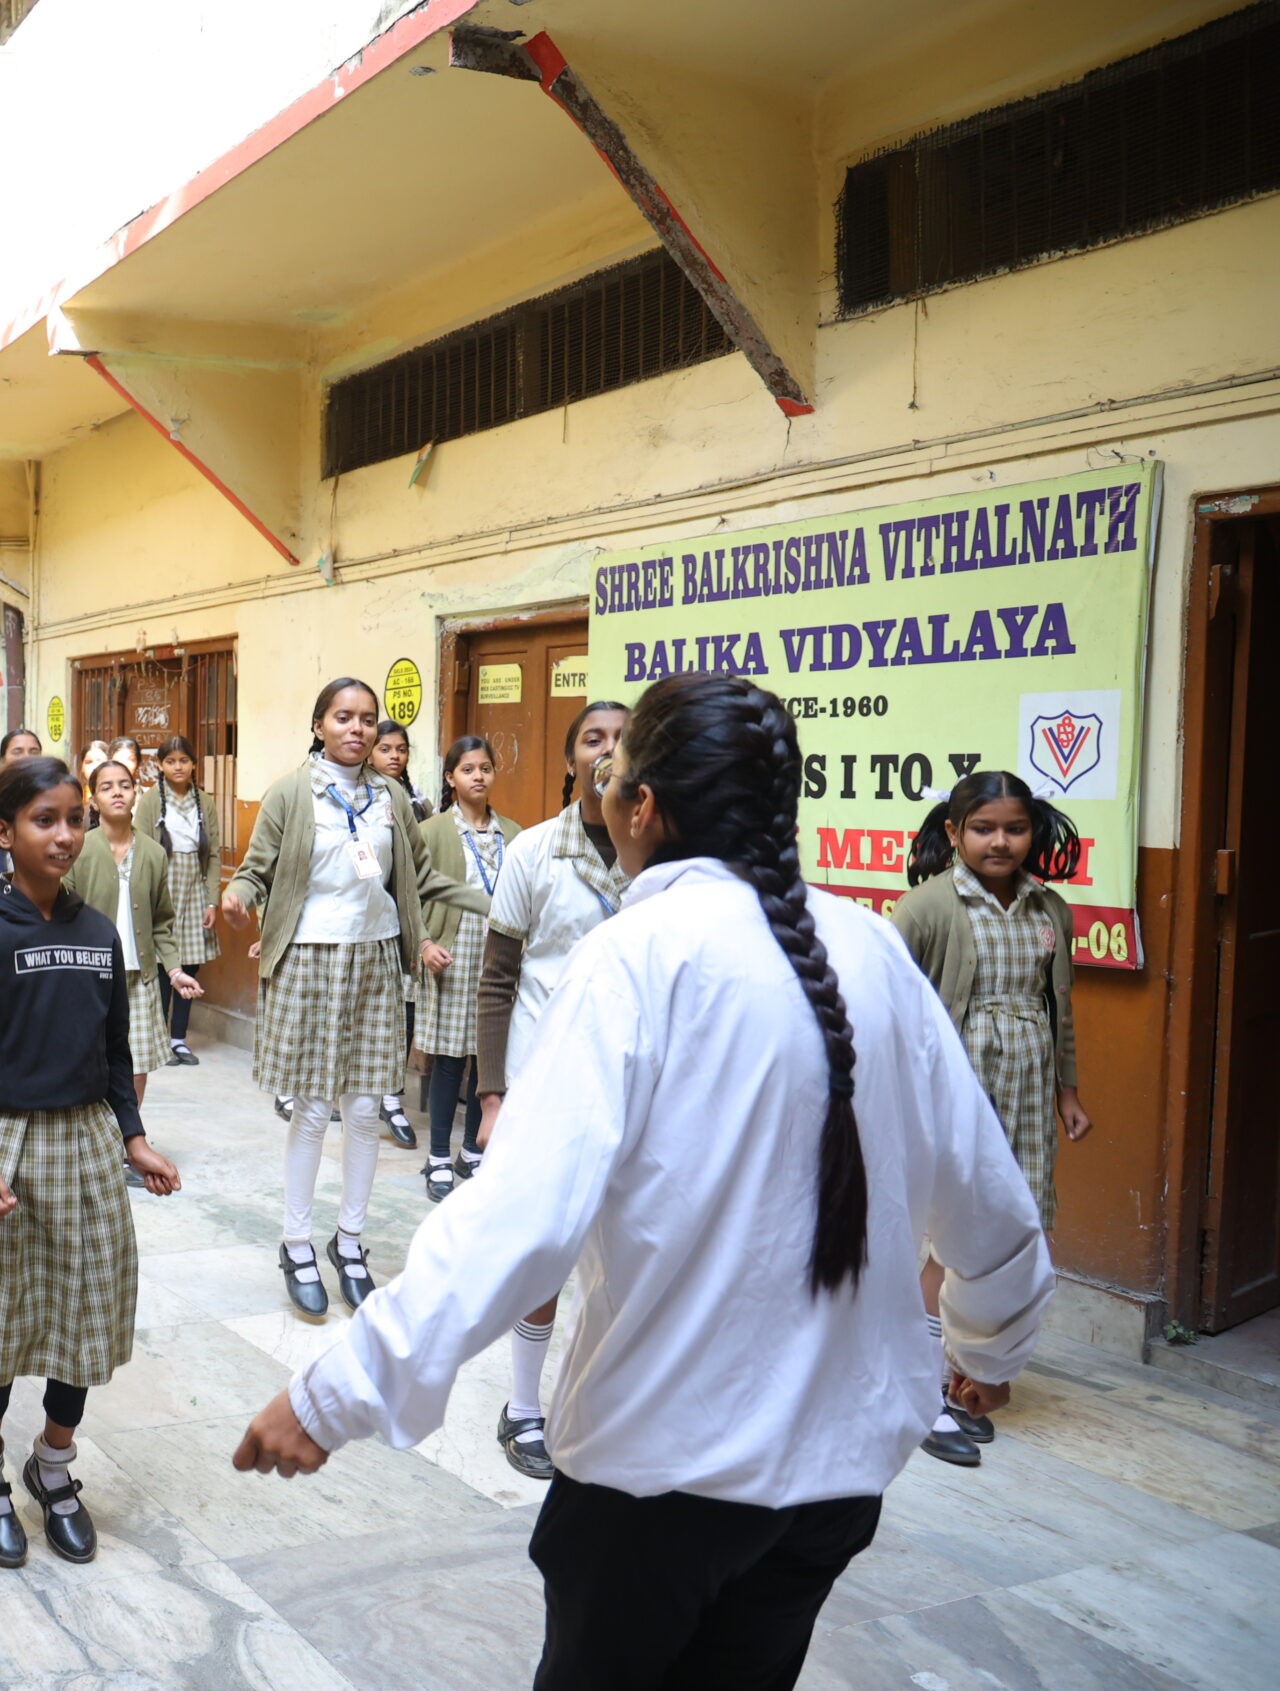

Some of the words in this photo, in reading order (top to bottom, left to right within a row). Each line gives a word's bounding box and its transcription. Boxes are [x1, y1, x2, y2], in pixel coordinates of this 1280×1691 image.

[595, 553, 675, 616] SHREE
[681, 527, 870, 606] BALKRISHNA
[879, 482, 1142, 581] VITHALNATH
[624, 632, 769, 682] BALIKA
[780, 603, 1077, 674] VIDYALAYA
[554, 672, 588, 688] ENTR
[391, 701, 415, 720] 189
[871, 753, 933, 802] TO
[24, 950, 51, 968] WHAT
[54, 949, 74, 964] YOU
[76, 950, 112, 967] BELIEVE
